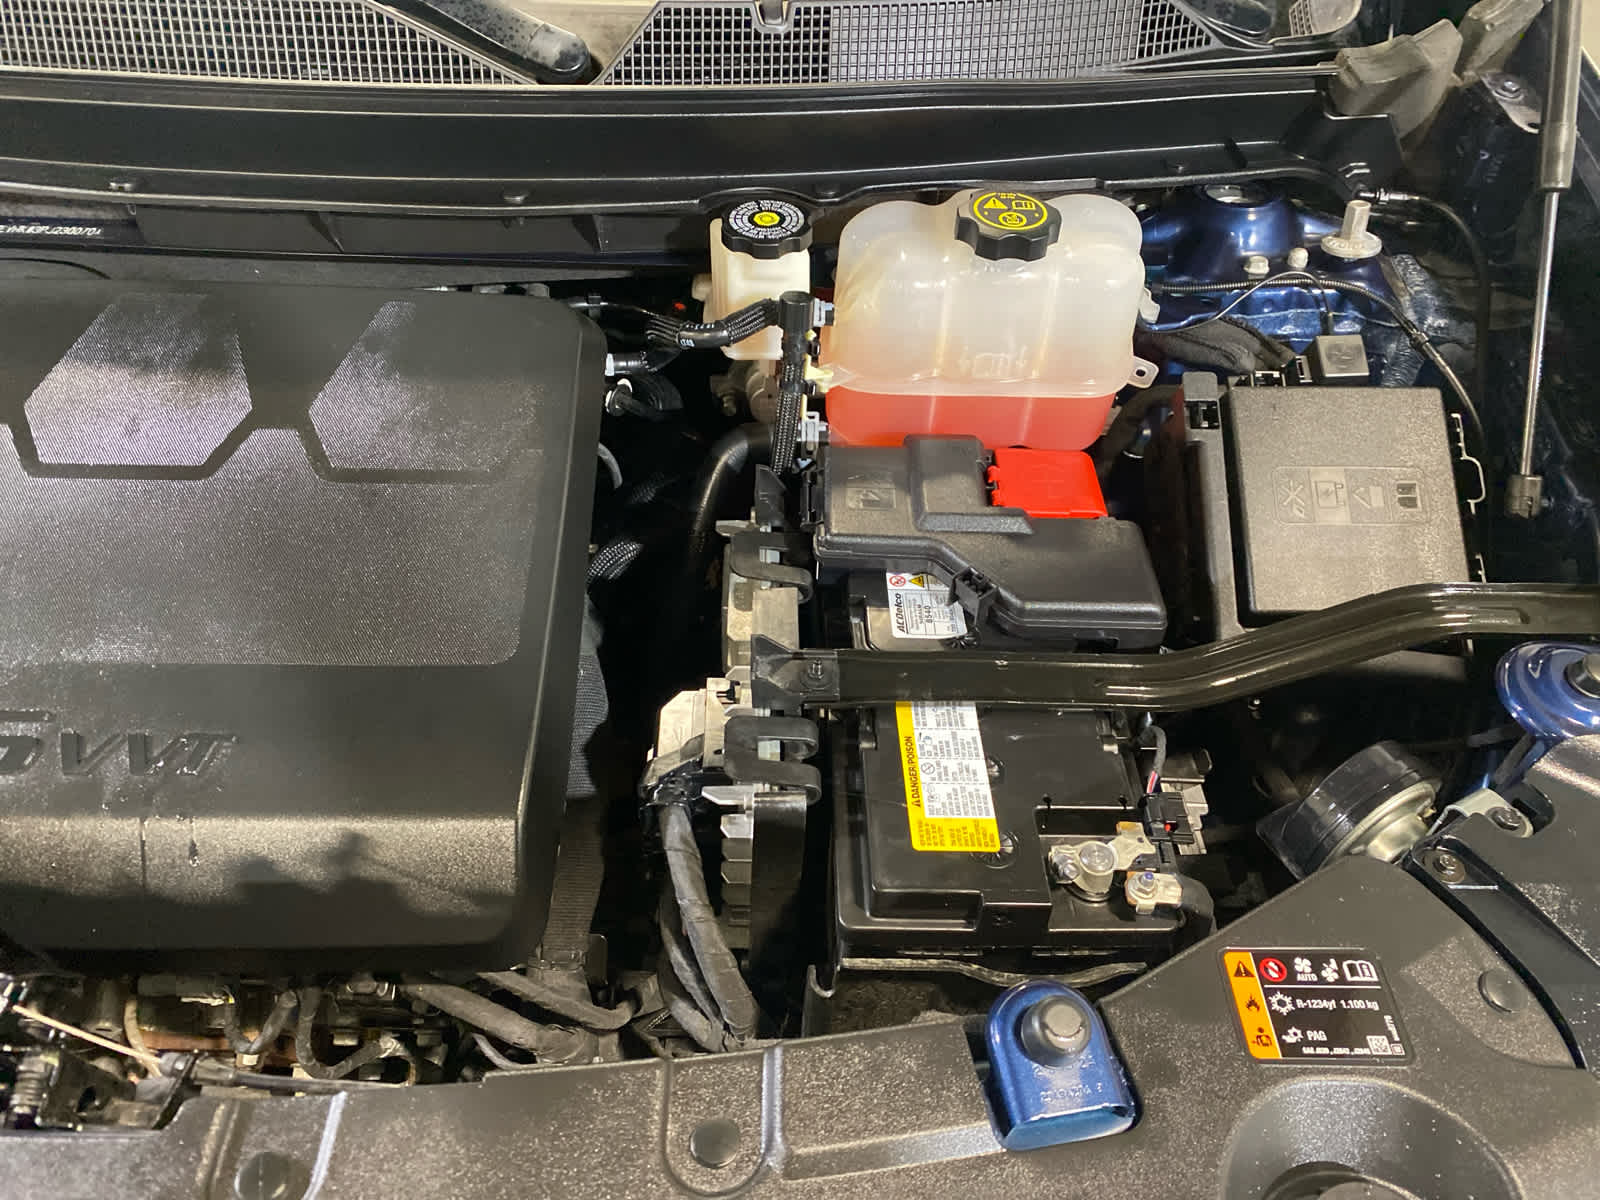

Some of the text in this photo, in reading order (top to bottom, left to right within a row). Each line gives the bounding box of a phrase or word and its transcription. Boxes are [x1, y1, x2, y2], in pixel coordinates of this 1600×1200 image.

[894, 593, 906, 633] ACDelco
[1297, 974, 1318, 982] AUTO
[1340, 999, 1365, 1009] 1.100
[1366, 1000, 1380, 1011] kg
[1306, 1030, 1328, 1041] PAG
